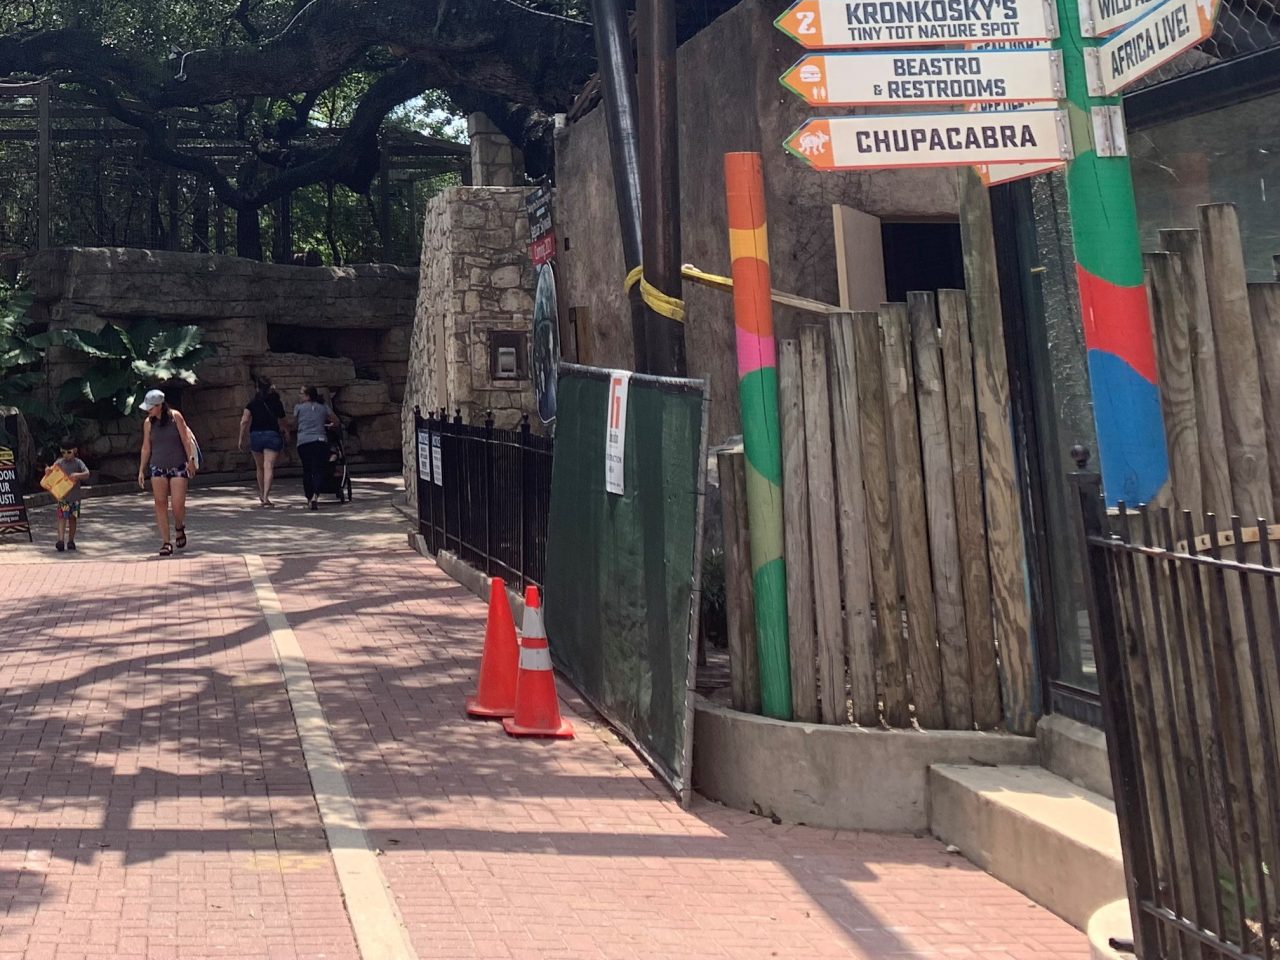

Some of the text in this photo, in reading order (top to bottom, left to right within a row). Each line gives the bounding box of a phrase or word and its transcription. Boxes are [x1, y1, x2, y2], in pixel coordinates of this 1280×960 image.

[848, 22, 1019, 41] TINY TOT NATURE SPOT
[1111, 4, 1190, 79] AFRICA LIVE!
[893, 57, 981, 77] BEASTRO
[873, 79, 1007, 98] & RESTROOMS
[856, 125, 1037, 154] CHUPACABRA
